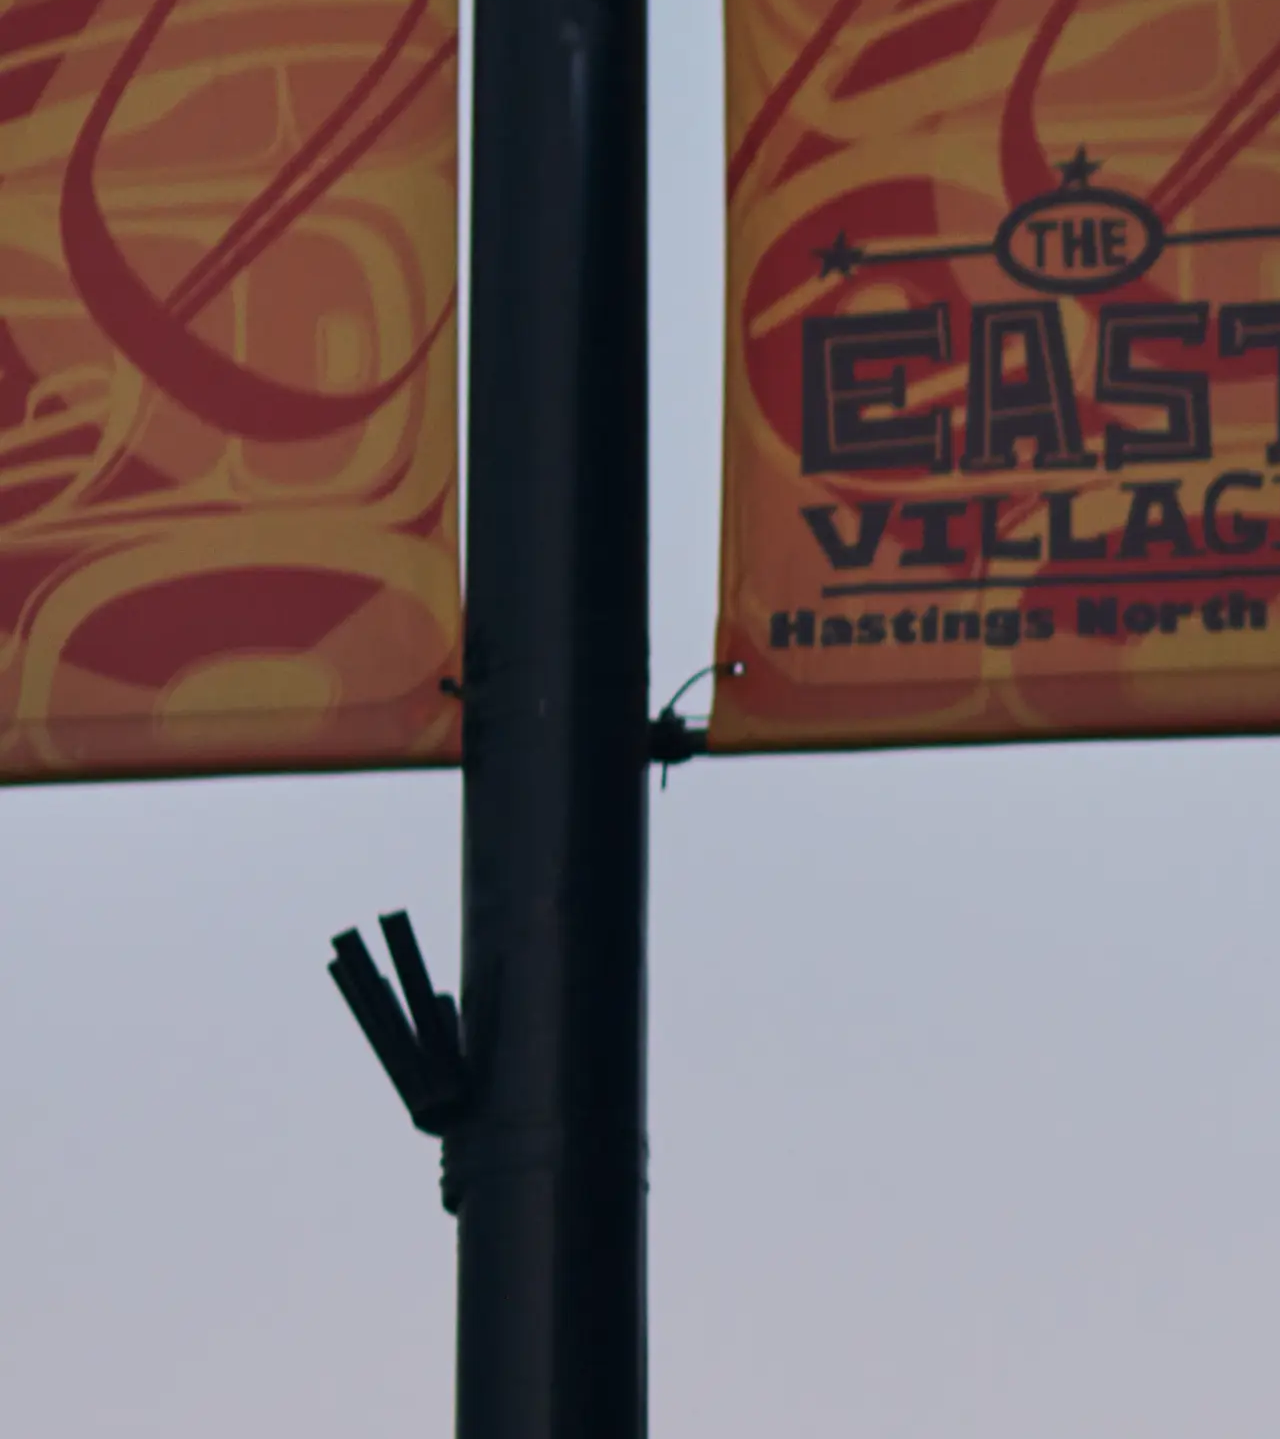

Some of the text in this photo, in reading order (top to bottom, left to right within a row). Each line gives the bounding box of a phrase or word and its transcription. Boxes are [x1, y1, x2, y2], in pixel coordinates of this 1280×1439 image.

[1027, 216, 1127, 271] THE
[770, 604, 1055, 649] Hastings
[1077, 589, 1267, 638] North
